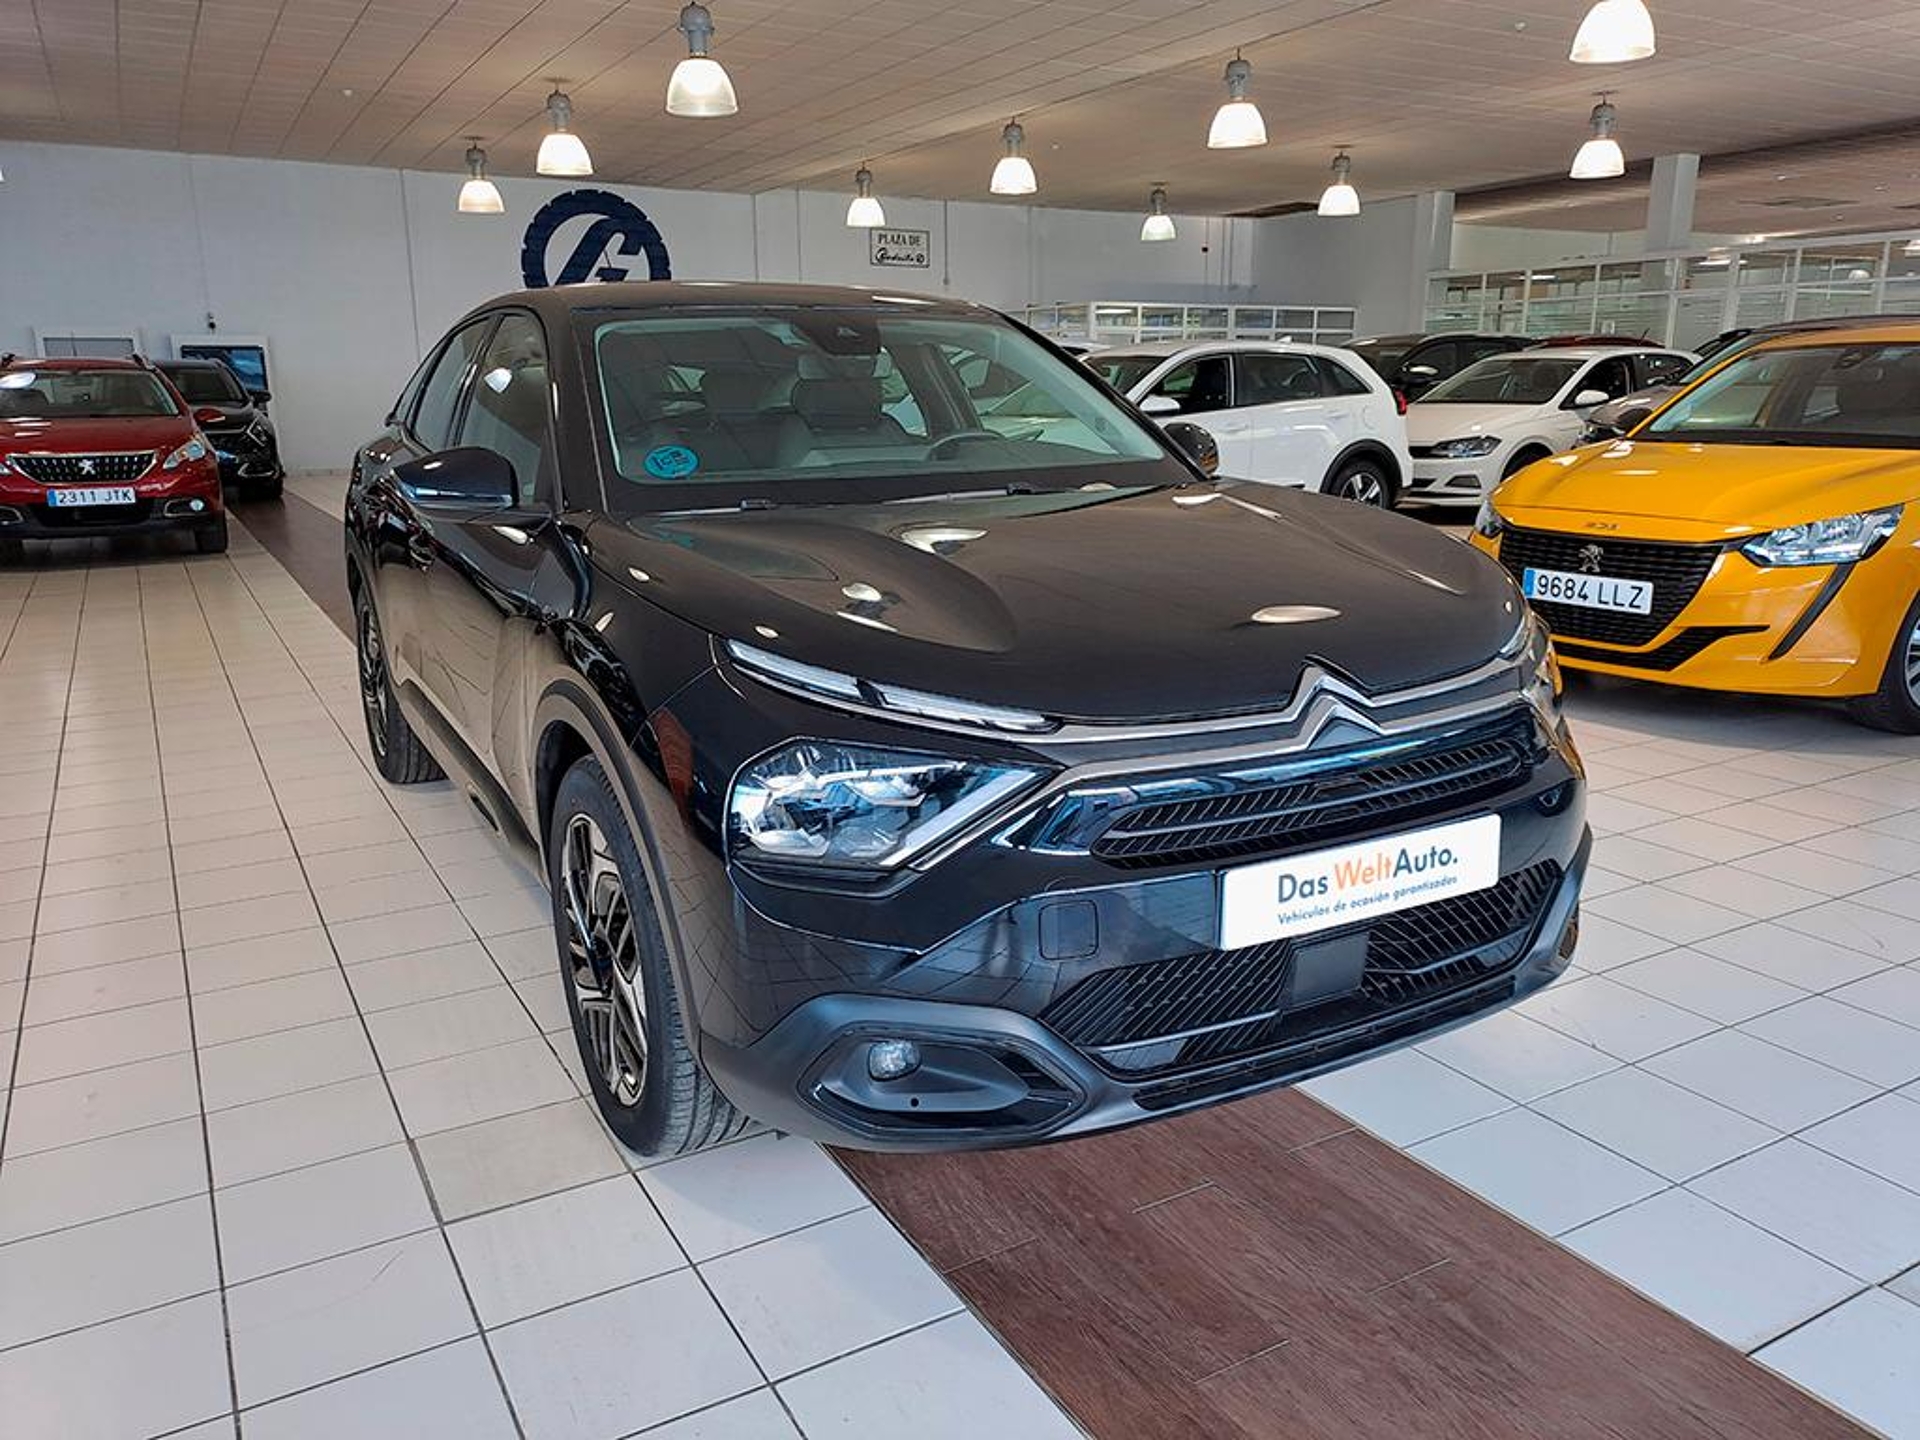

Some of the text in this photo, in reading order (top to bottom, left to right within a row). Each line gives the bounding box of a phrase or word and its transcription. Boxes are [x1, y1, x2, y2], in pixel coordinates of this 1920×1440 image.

[878, 233, 921, 246] PLAZA DE
[58, 491, 98, 504] 2311
[1537, 574, 1644, 609] 9684 LLZ
[1278, 873, 1328, 903] Das
[1333, 900, 1347, 912] de
[1393, 875, 1458, 900] garantizados
